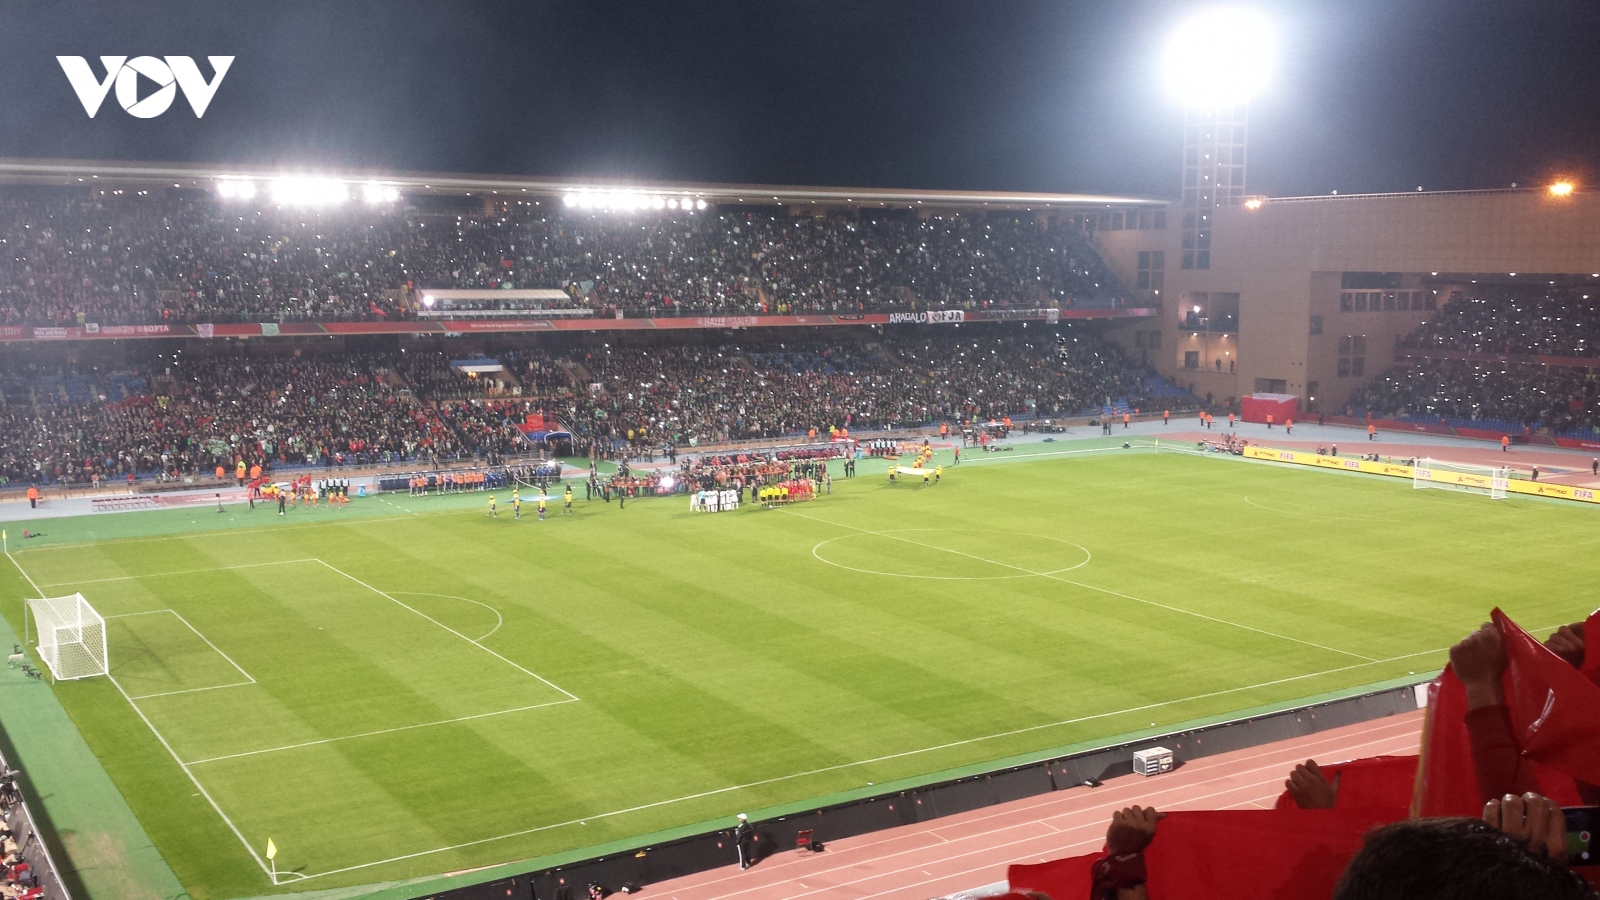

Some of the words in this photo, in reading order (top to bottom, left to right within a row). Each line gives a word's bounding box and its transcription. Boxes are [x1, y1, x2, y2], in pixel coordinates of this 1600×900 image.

[143, 325, 170, 333] SOFIA
[1280, 453, 1294, 461] FIFA
[1344, 460, 1360, 469] FIFA
[1416, 469, 1431, 478] FIFA
[1574, 489, 1593, 499] FIFA
